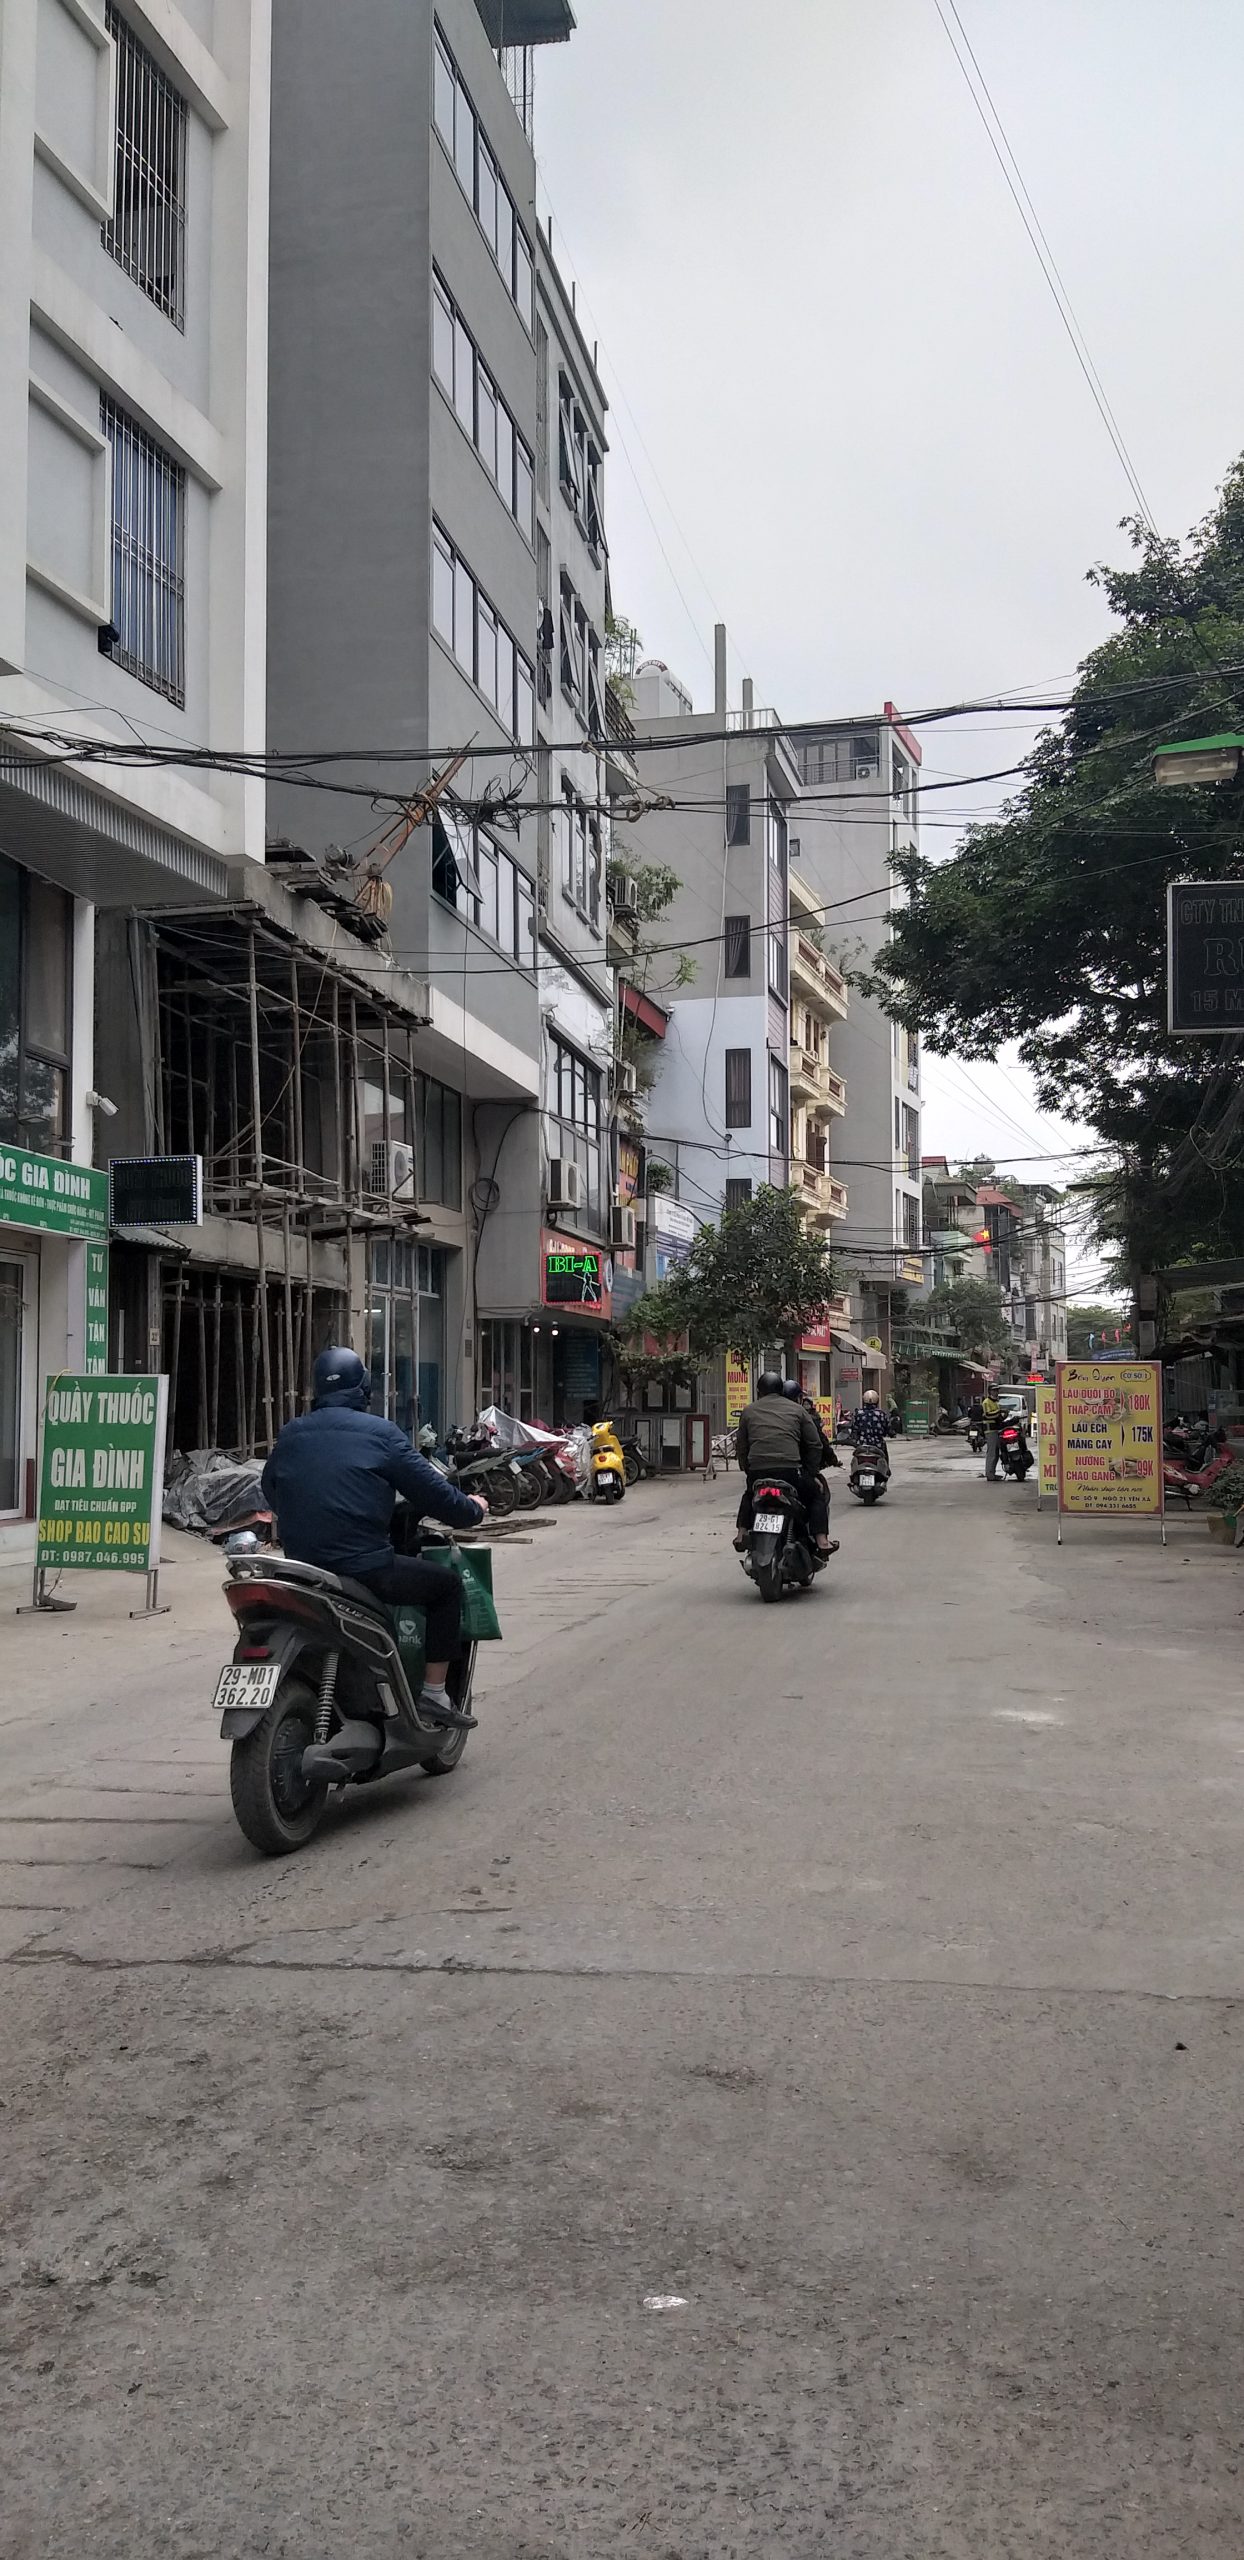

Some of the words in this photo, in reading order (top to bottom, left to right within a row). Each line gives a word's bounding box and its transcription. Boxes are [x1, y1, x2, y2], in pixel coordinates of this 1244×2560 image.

[1181, 899, 1216, 925] CTY
[1192, 990, 1218, 1011] 15
[22, 1162, 49, 1190] GIA
[54, 1169, 90, 1200] ĐÌNH
[91, 1252, 104, 1273] TƯ
[549, 1256, 598, 1272] BI-A
[88, 1282, 106, 1307] VẤN
[88, 1320, 105, 1346] TẬN
[48, 1381, 93, 1425] QUẦY
[97, 1382, 154, 1425] THUỐC
[1129, 1394, 1150, 1411] 180K
[1095, 1439, 1113, 1449] CAY
[1132, 1426, 1153, 1443] 175K
[51, 1447, 86, 1488] GIA
[92, 1443, 145, 1490] ĐÌNH
[1137, 1460, 1153, 1476] 99K
[55, 1500, 70, 1513] ĐẠT
[72, 1498, 89, 1512] TIÊU
[90, 1497, 119, 1513] CHUẨN
[120, 1501, 137, 1513] GPP
[39, 1519, 73, 1543] SHOP
[75, 1520, 101, 1544] BAO
[104, 1521, 130, 1545] CAO
[133, 1522, 150, 1546] SU
[41, 1550, 60, 1562] ĐT:
[63, 1551, 145, 1565] 0987.046.995
[222, 1667, 274, 1686] 29-MD1
[217, 1687, 270, 1706] 362.20
